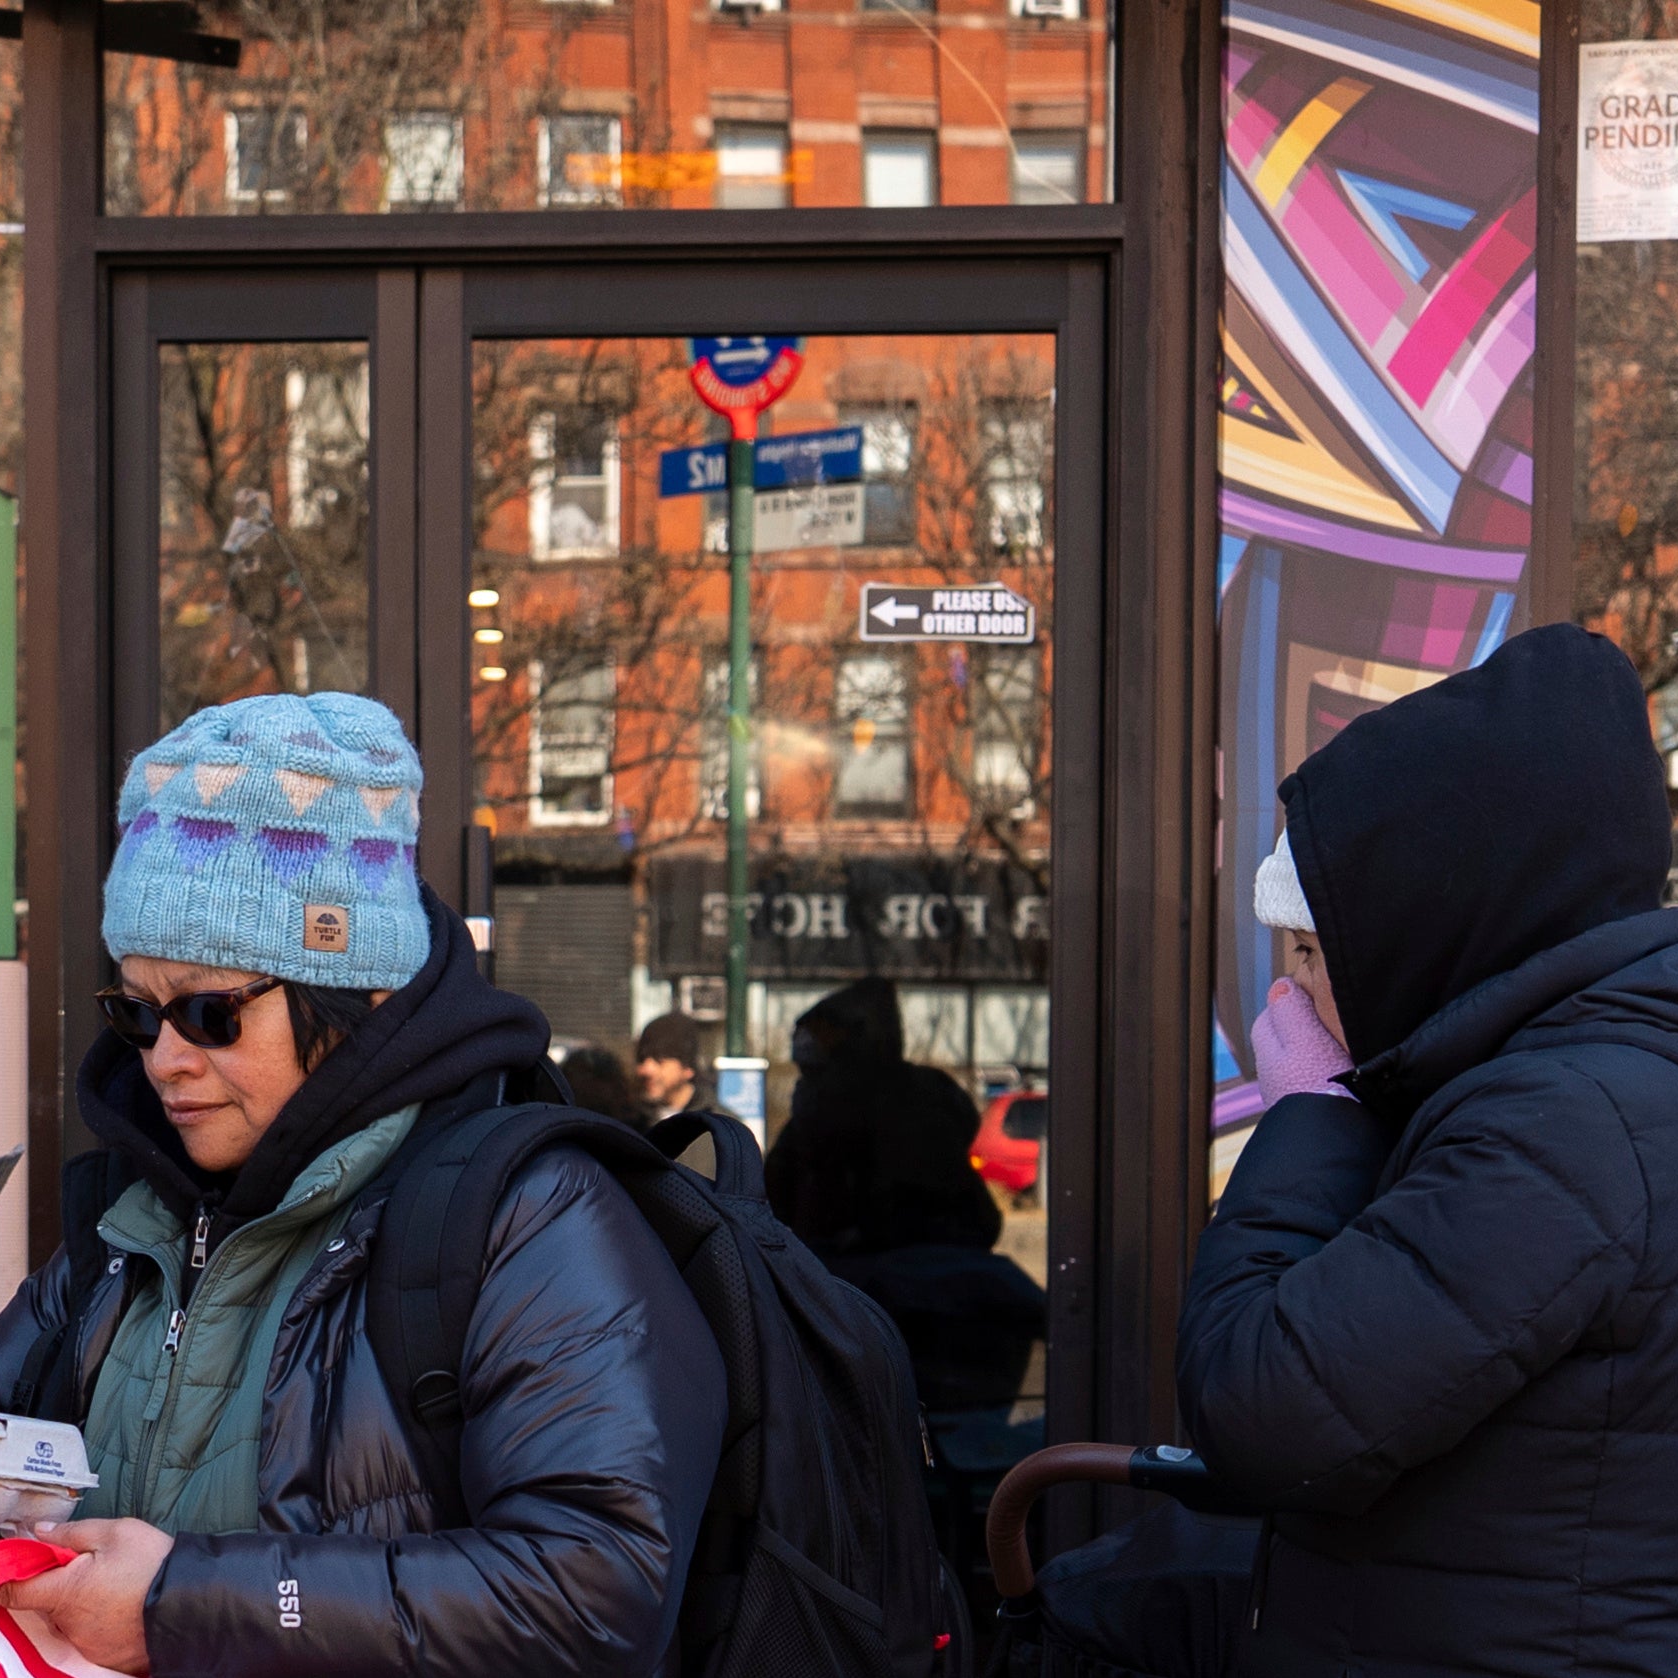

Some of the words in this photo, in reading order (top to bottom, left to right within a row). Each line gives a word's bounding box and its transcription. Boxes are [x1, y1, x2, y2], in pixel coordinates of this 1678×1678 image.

[933, 590, 991, 612] PLEASE
[993, 591, 1025, 612] US
[922, 613, 976, 634] OTHER
[978, 614, 1025, 635] DOOR
[314, 927, 341, 935] TURTLE
[279, 1579, 301, 1629] 550
